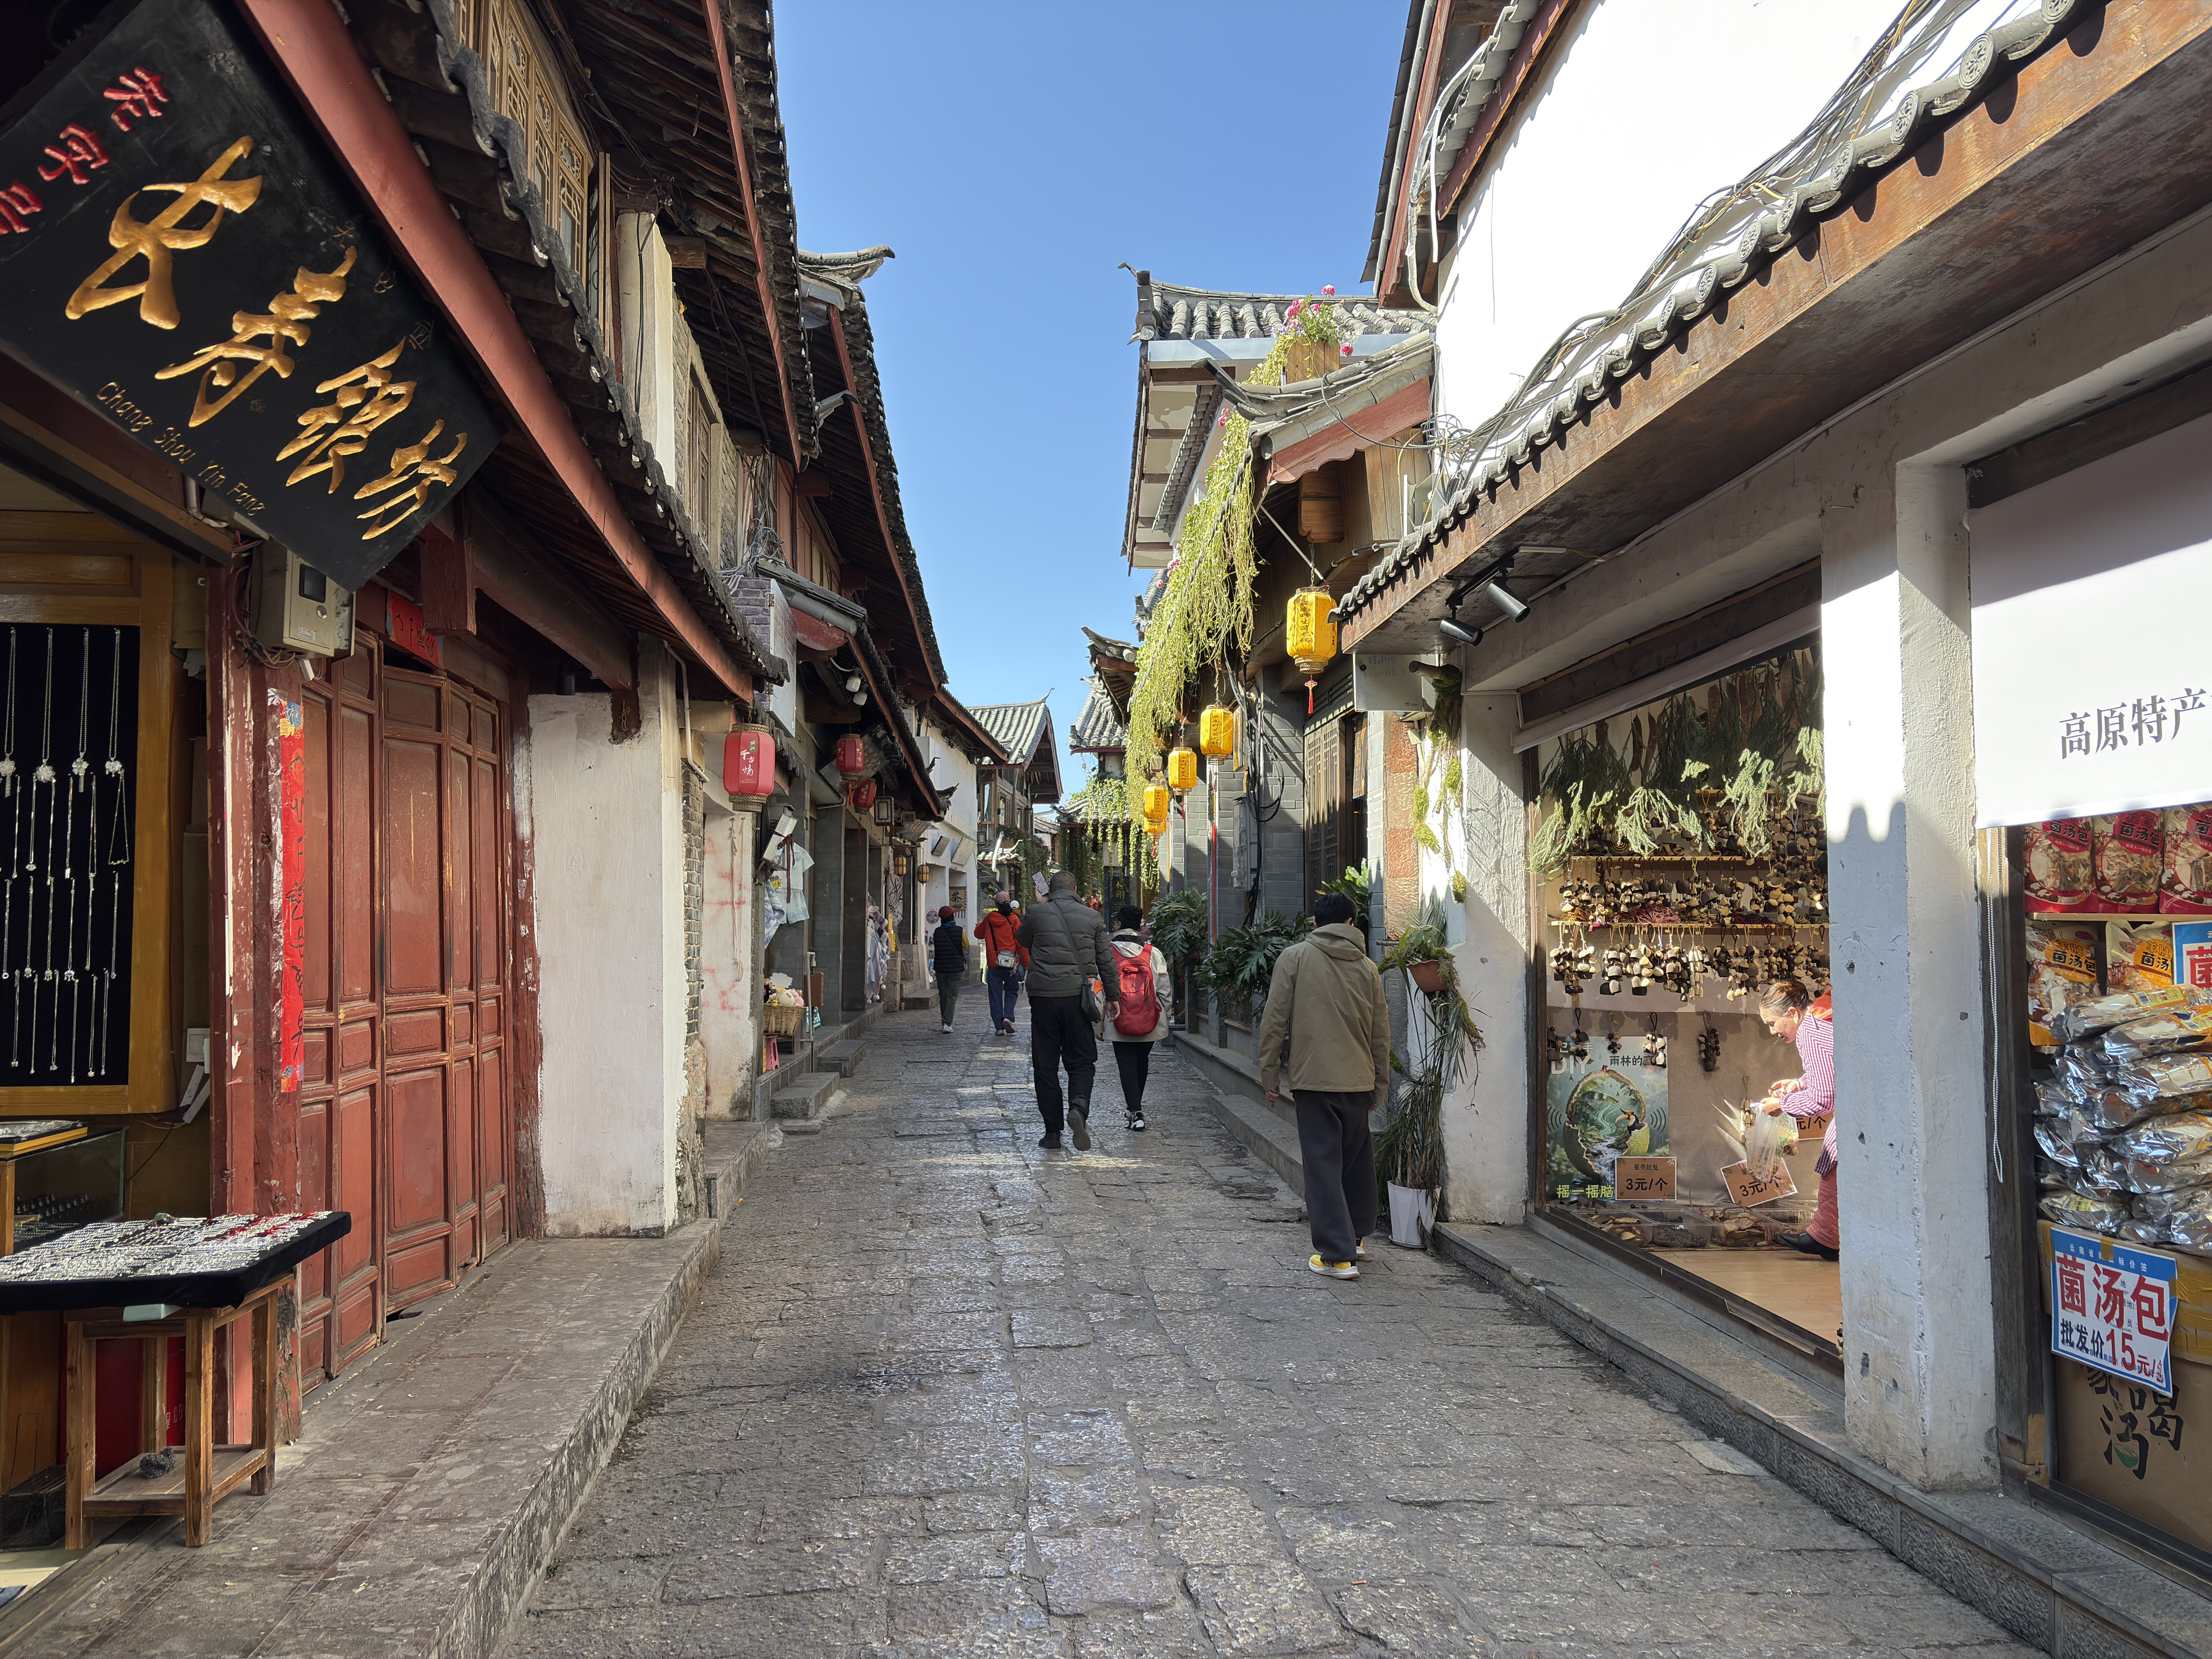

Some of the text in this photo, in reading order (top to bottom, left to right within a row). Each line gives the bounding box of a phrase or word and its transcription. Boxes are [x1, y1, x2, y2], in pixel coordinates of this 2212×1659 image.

[97, 382, 265, 516] Chang Shou Yin Fang
[2059, 687, 2212, 760] 高原特产
[2049, 820, 2088, 844] 菌汤包
[2120, 822, 2160, 846] 菌汤包
[950, 890, 963, 904] 茶
[2052, 949, 2096, 974] 菌汤包
[2141, 951, 2169, 972] 菌汤
[1551, 1055, 1591, 1074] DIY
[1556, 1184, 1614, 1199] 摇一摇脑
[1625, 1177, 1668, 1192] 3元/个
[2069, 1244, 2147, 1272] 云南省标价签
[2056, 1253, 2169, 1342] 菌汤包
